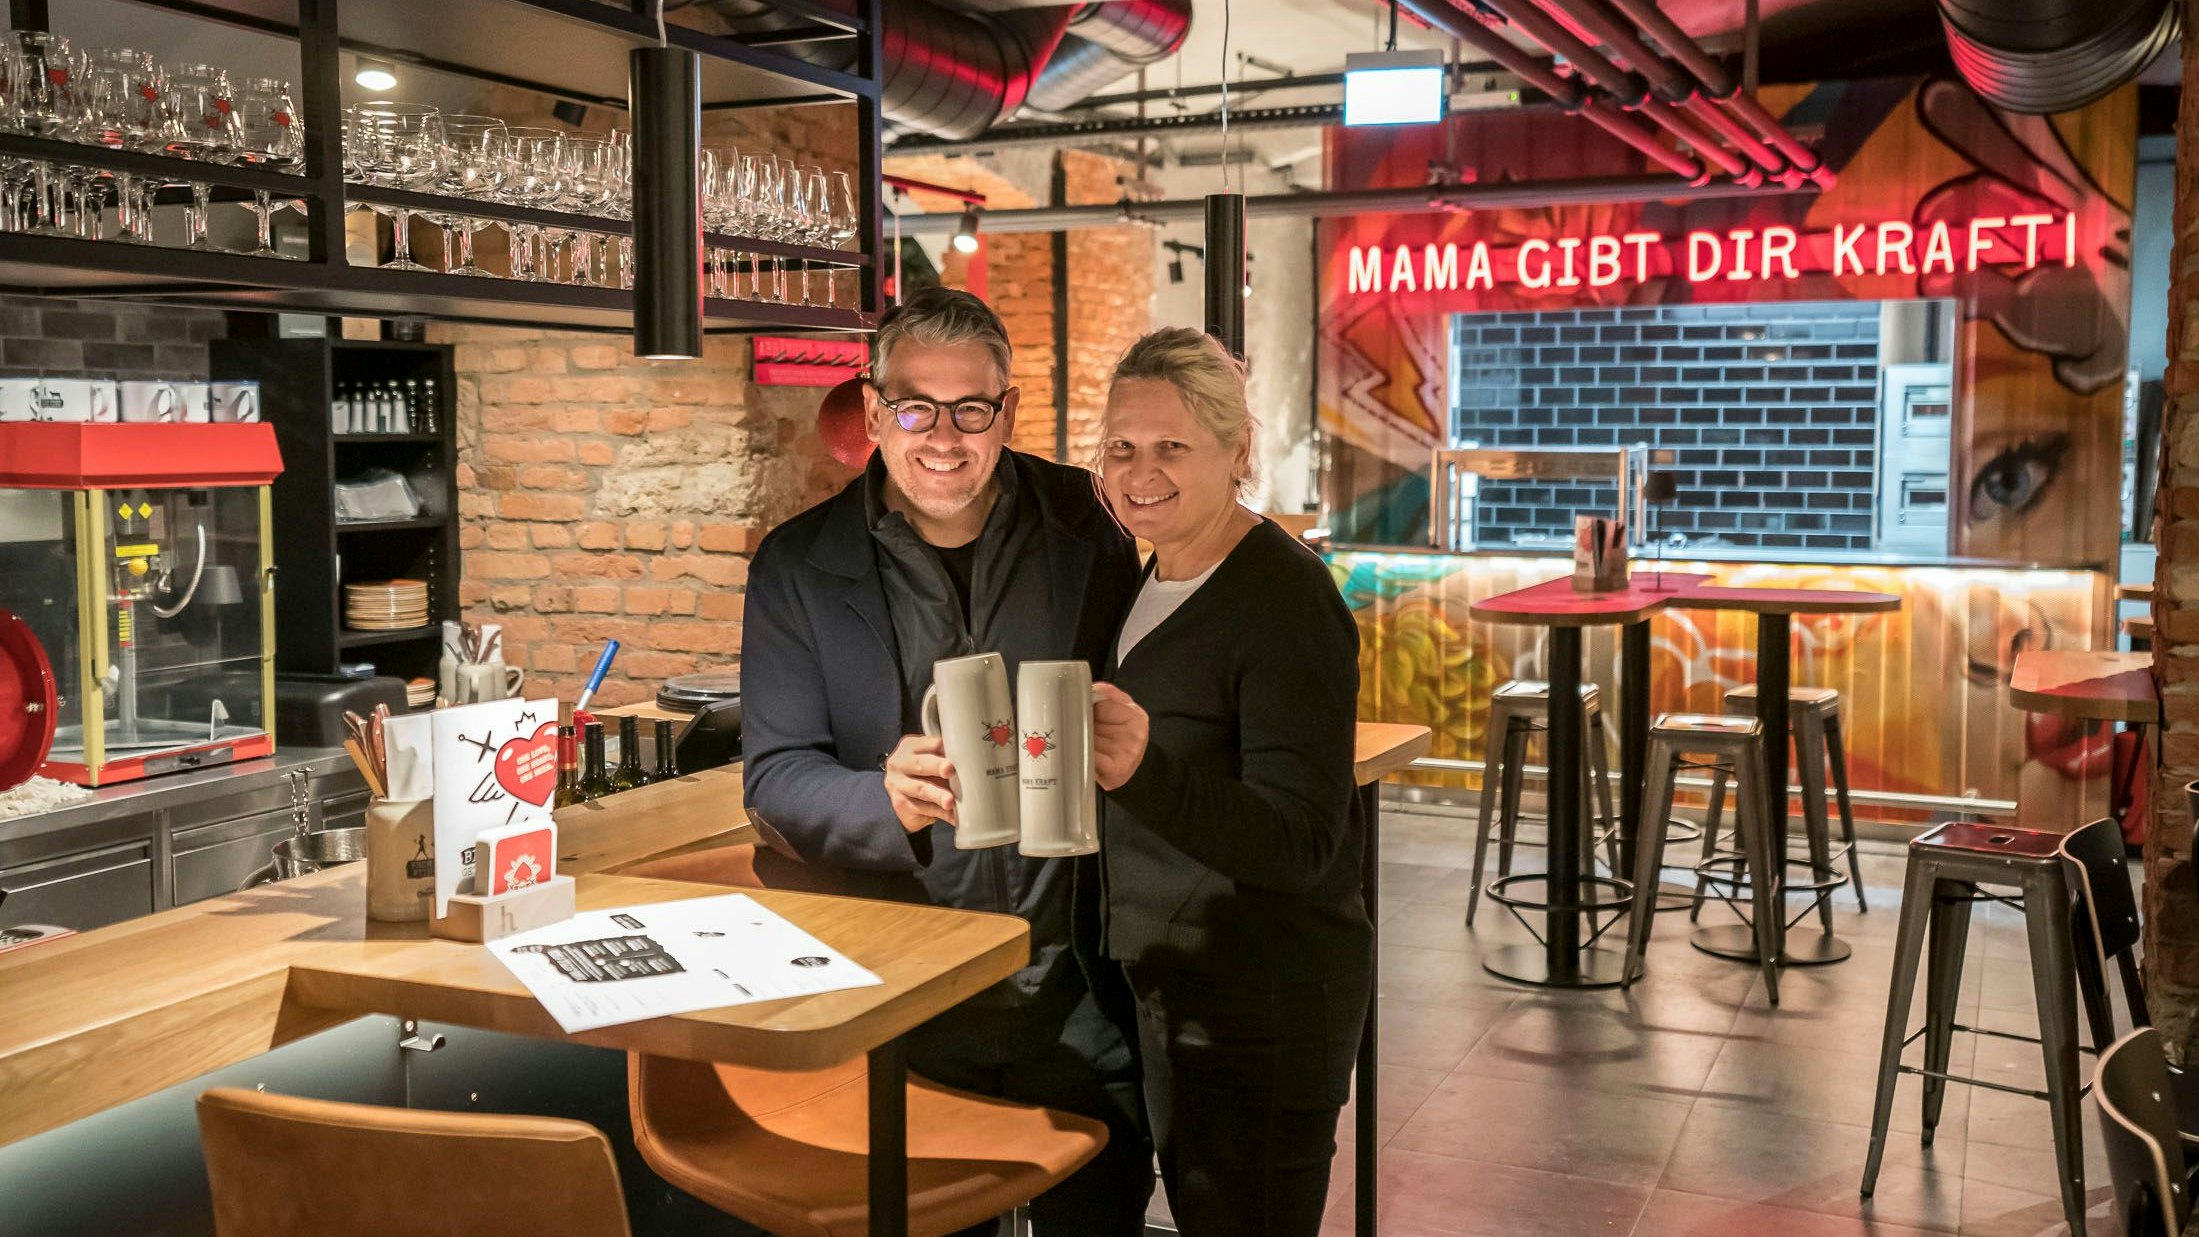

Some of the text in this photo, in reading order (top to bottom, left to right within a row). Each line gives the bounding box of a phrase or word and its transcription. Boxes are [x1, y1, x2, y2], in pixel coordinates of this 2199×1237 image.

[1347, 241, 1494, 295] MAMA
[1515, 231, 1661, 289] GIBT
[1687, 226, 1800, 283] DIR
